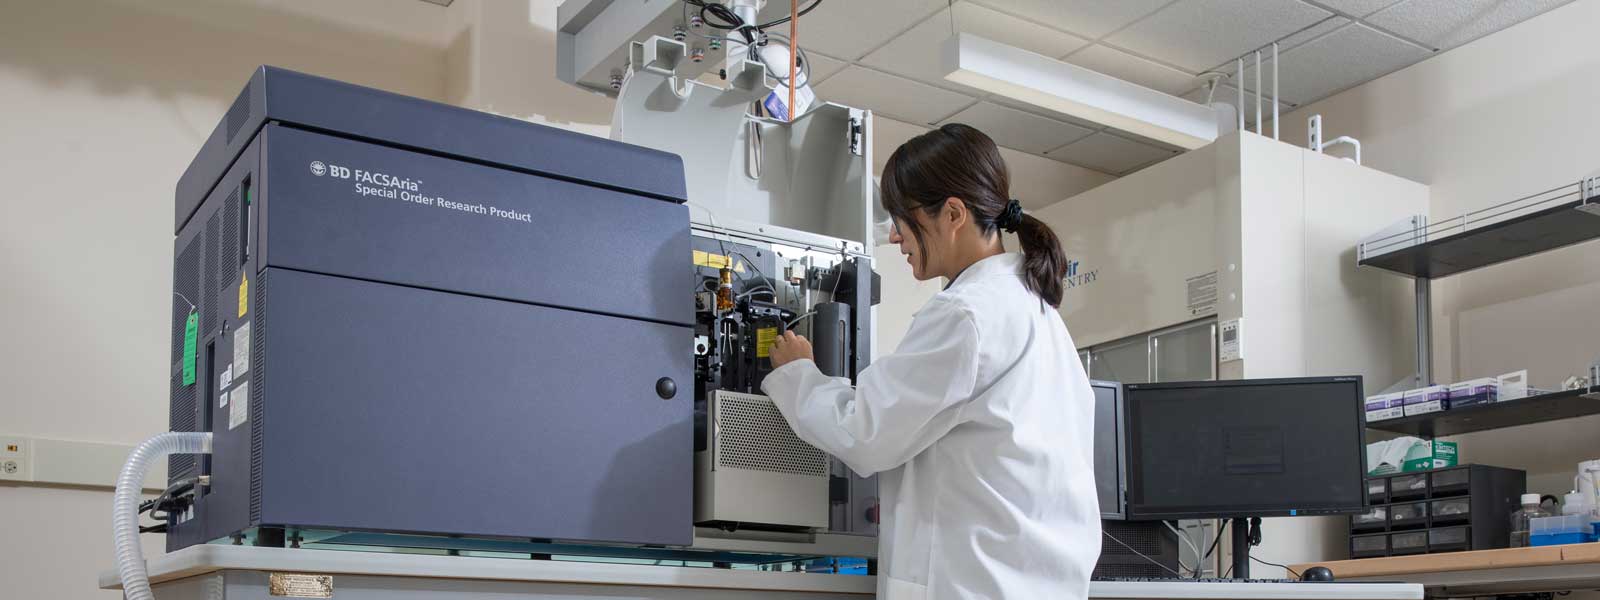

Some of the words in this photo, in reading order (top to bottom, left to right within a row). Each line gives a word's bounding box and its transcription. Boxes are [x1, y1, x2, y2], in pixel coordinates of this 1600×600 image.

[329, 164, 351, 179] BD
[355, 183, 397, 199] Special
[400, 191, 434, 206] Order
[437, 197, 487, 215] Research
[489, 206, 532, 223] Product
[1067, 259, 1079, 278] ir
[1062, 269, 1098, 289] ENTRY
